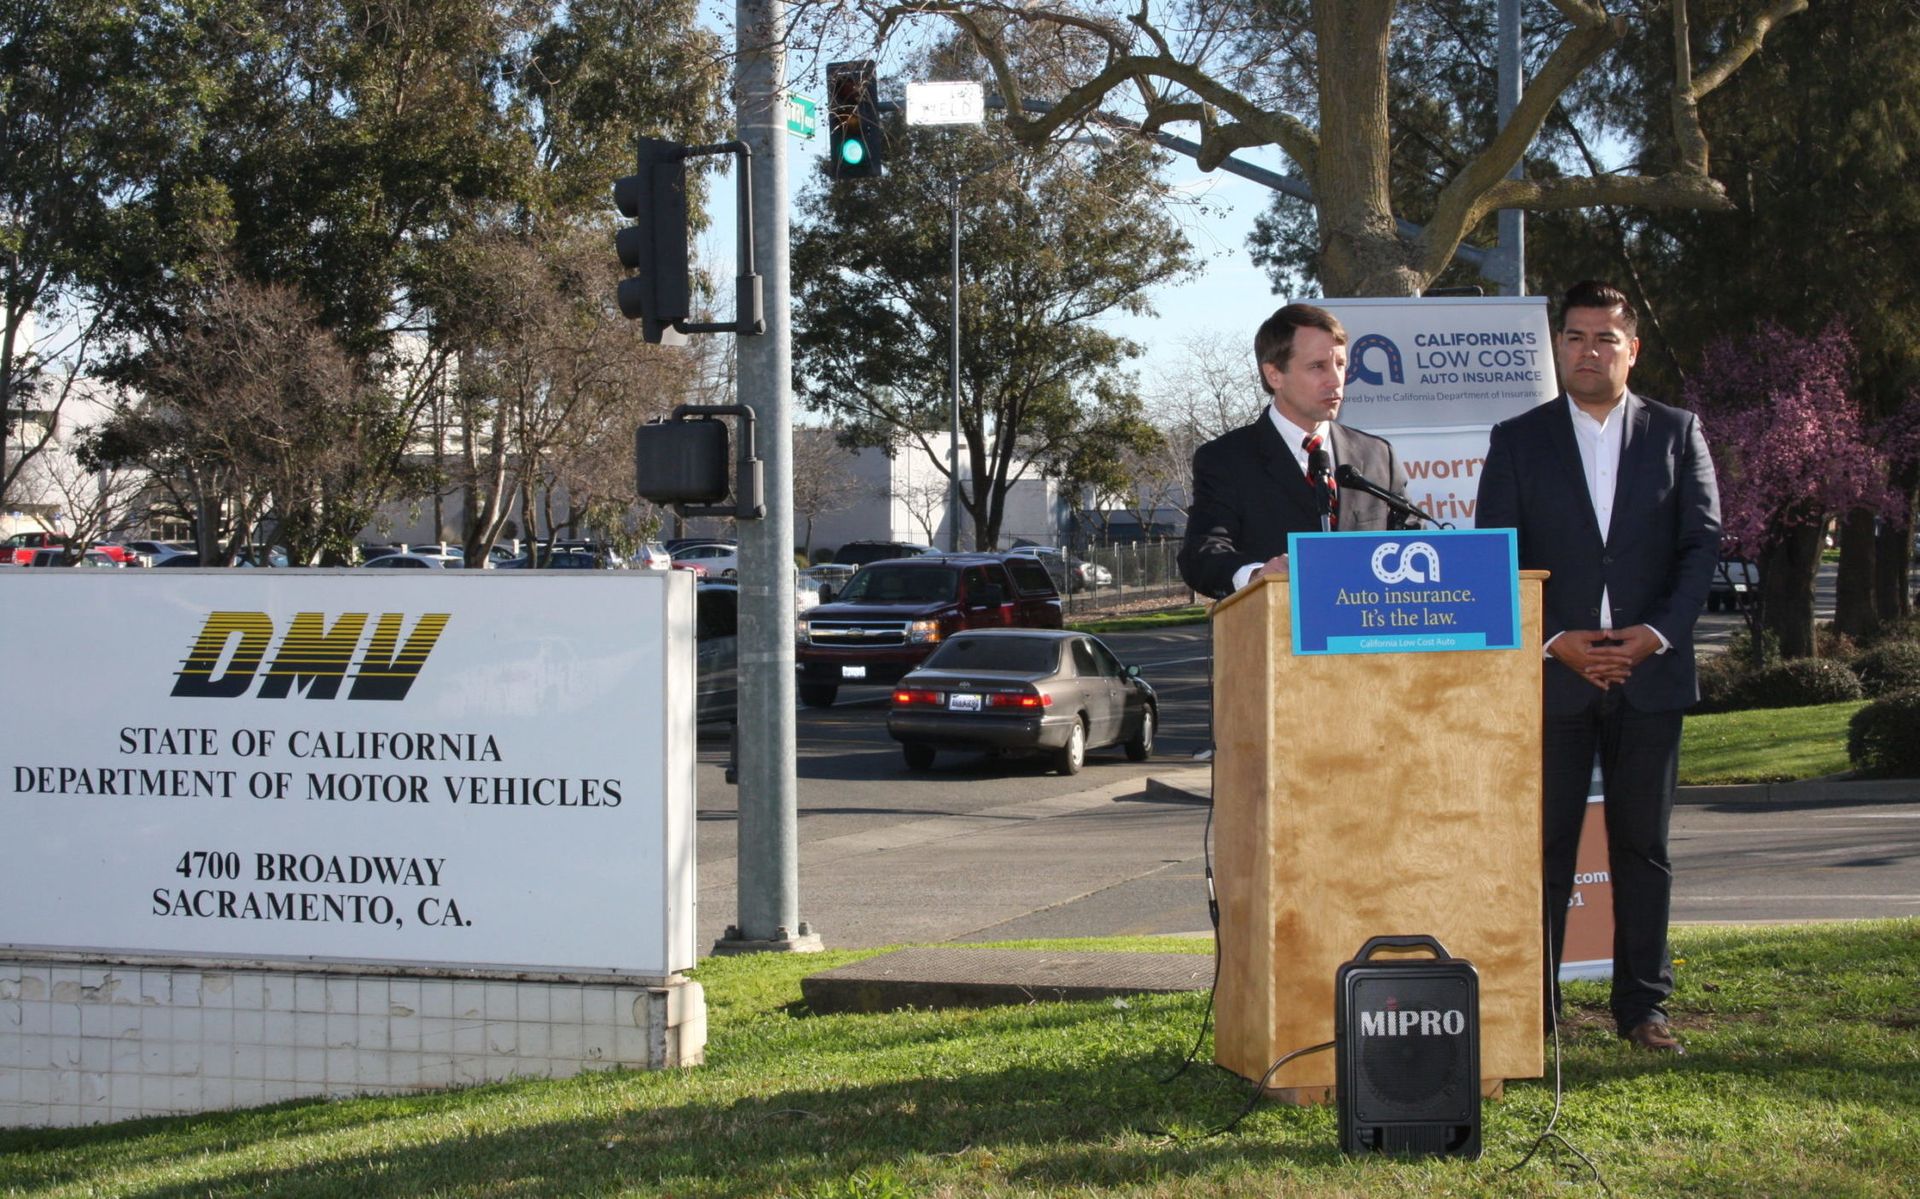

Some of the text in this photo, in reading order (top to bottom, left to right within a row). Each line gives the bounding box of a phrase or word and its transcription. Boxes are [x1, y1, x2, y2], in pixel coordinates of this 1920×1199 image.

[1414, 332, 1537, 347] CALIFORNIA'S
[1416, 349, 1538, 369] LOW COST
[1420, 371, 1542, 385] AUTO INSURANCE
[1364, 394, 1374, 404] by
[1376, 393, 1391, 402] the
[1393, 391, 1435, 402] California
[1436, 391, 1492, 402] Department
[1492, 390, 1501, 399] of
[1415, 493, 1477, 519] driv
[1336, 587, 1476, 605] Auto insurance.
[1361, 608, 1457, 627] It's the law.
[1360, 637, 1456, 649] California Low Cost Auto
[170, 611, 452, 701] DMV
[120, 727, 502, 763] STATE OF CALIFORNIA
[14, 766, 622, 808] DEPARTMENT OF MOTOR VEHICLES
[176, 851, 446, 888] 4700 BROADWAY
[152, 888, 472, 929] SACRAMENTO, CA.
[1360, 1009, 1465, 1037] MIPRO
